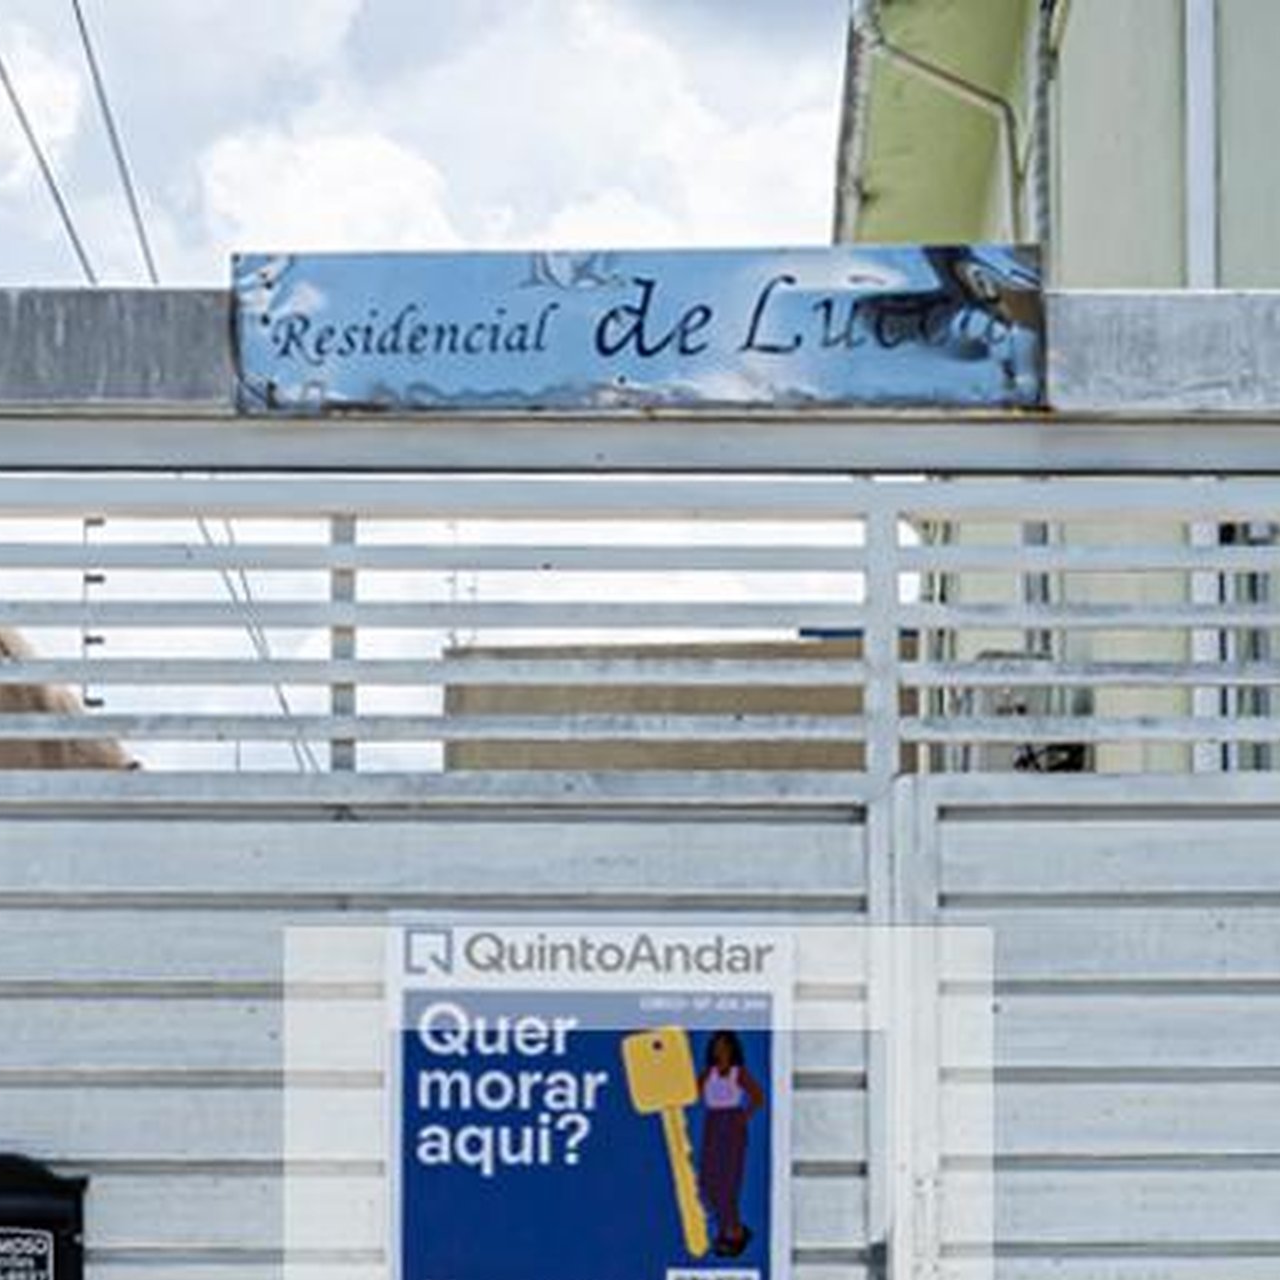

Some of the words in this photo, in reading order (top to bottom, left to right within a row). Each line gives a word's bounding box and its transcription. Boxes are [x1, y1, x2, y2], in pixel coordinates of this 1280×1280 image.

[271, 303, 558, 360] Residencial
[595, 277, 714, 358] de
[463, 930, 773, 973] QuintoAndar
[417, 1001, 579, 1056] Quer
[418, 1068, 608, 1111] morar
[416, 1113, 591, 1177] aqui?
